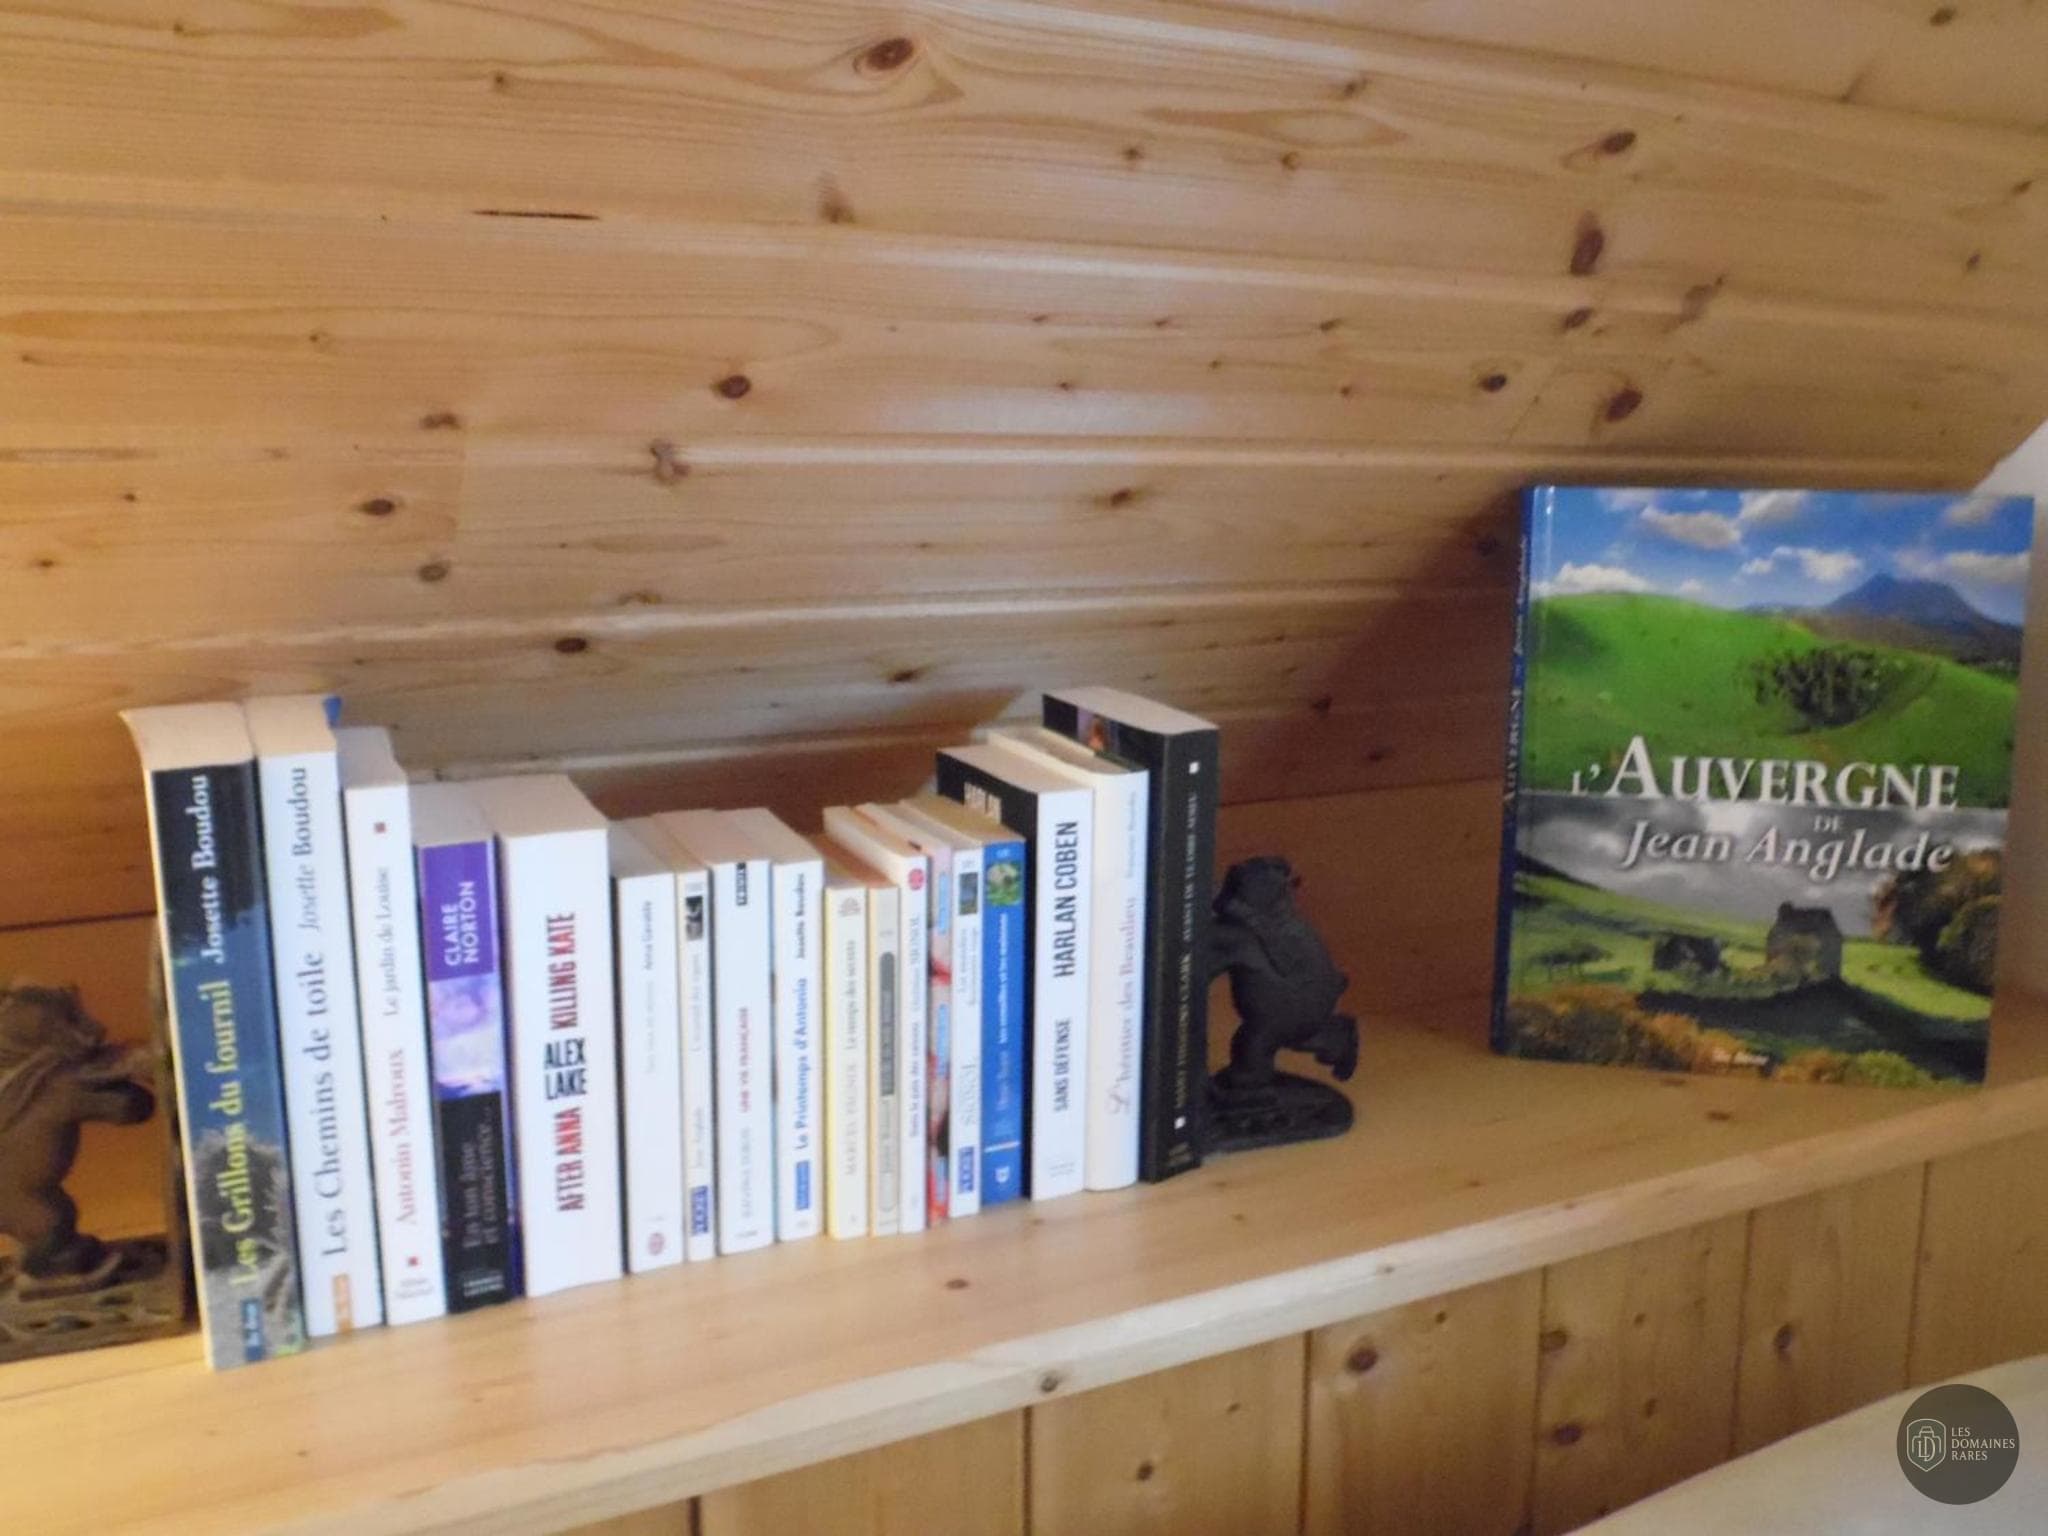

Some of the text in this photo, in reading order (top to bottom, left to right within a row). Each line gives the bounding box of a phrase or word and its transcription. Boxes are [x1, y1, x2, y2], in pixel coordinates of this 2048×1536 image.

[1571, 735, 1960, 811] L'AUVERGNE
[285, 767, 320, 933] Josette Boudou
[1620, 821, 1955, 881] Jean Anglade
[1814, 814, 1843, 832] DE
[185, 775, 225, 964] Josette Boudou
[1052, 820, 1079, 978] HARLAN COBEN
[375, 924, 394, 944] de
[440, 903, 461, 965] CLAIRE
[459, 880, 478, 963] NORTON
[295, 952, 328, 1017] toile
[545, 911, 579, 1030] KILLING KATE
[197, 980, 238, 1073] fournil
[381, 998, 400, 1016] Le
[301, 1028, 331, 1062] de
[543, 1037, 586, 1069] ALEX
[208, 1081, 243, 1115] du
[792, 1055, 811, 1129] Printemps
[1053, 1078, 1070, 1112] SANS
[309, 1071, 344, 1199] Chemins
[552, 1107, 585, 1212] AFTER ANNA
[215, 1122, 254, 1232] Grillons
[228, 1238, 261, 1287] Les
[319, 1208, 349, 1256] Les
